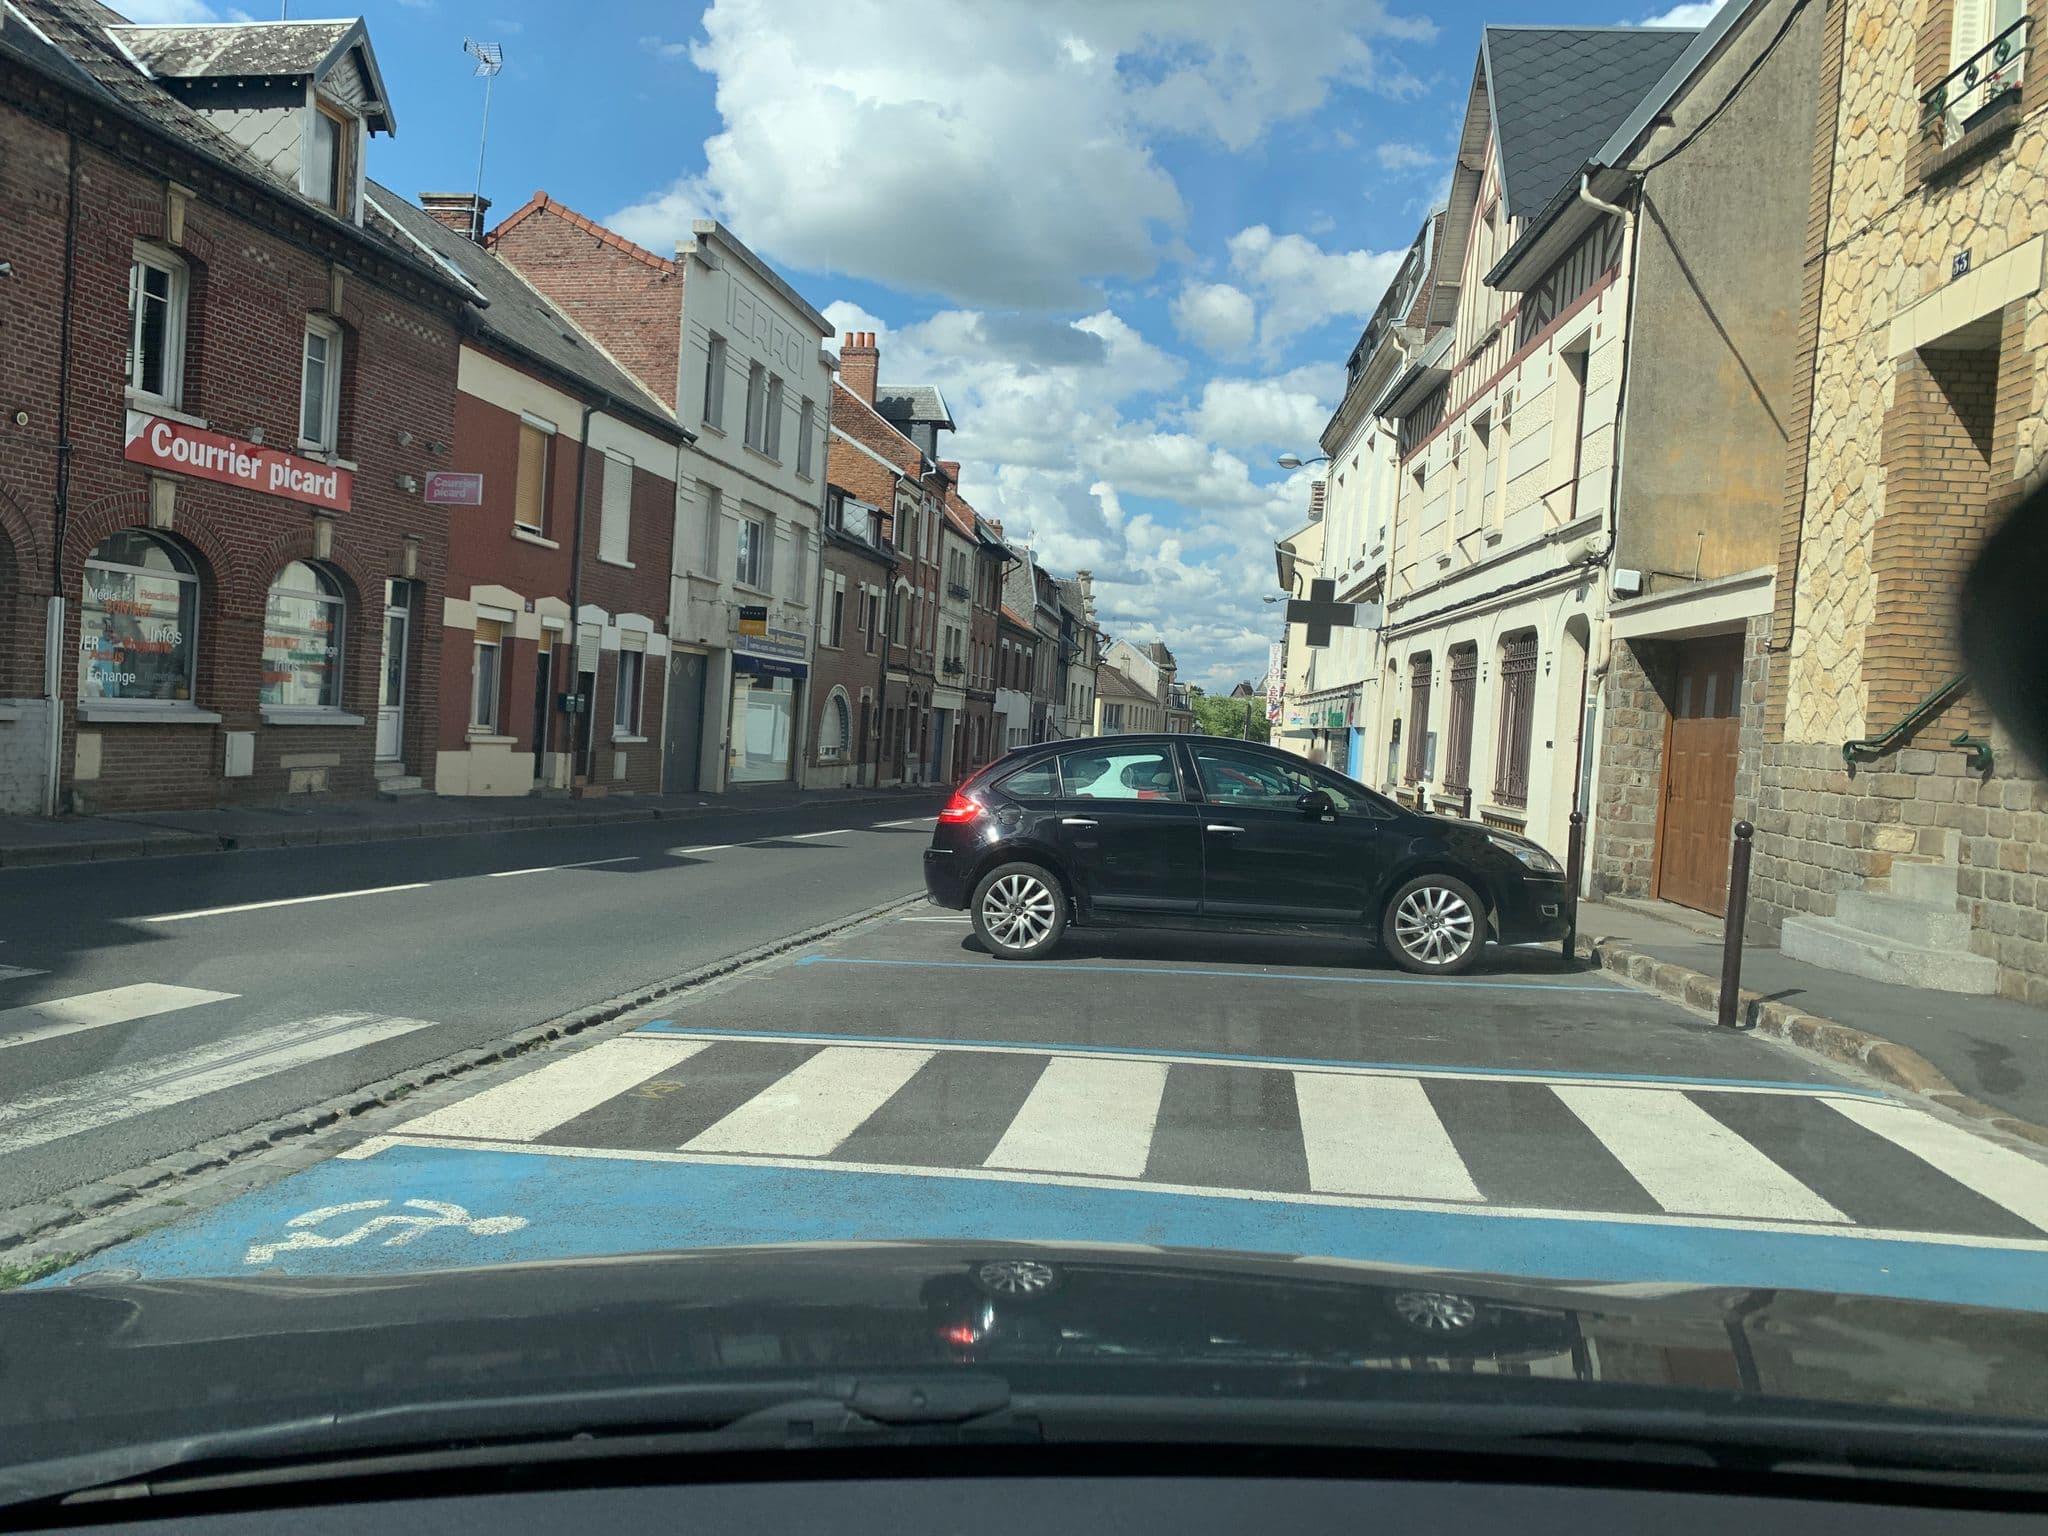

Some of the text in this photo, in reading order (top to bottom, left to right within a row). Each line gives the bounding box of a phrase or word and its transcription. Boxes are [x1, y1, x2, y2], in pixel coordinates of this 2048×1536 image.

[151, 422, 338, 500] Courrier picard
[434, 477, 478, 489] Courrier
[433, 487, 466, 498] picard
[150, 626, 183, 645] Infos
